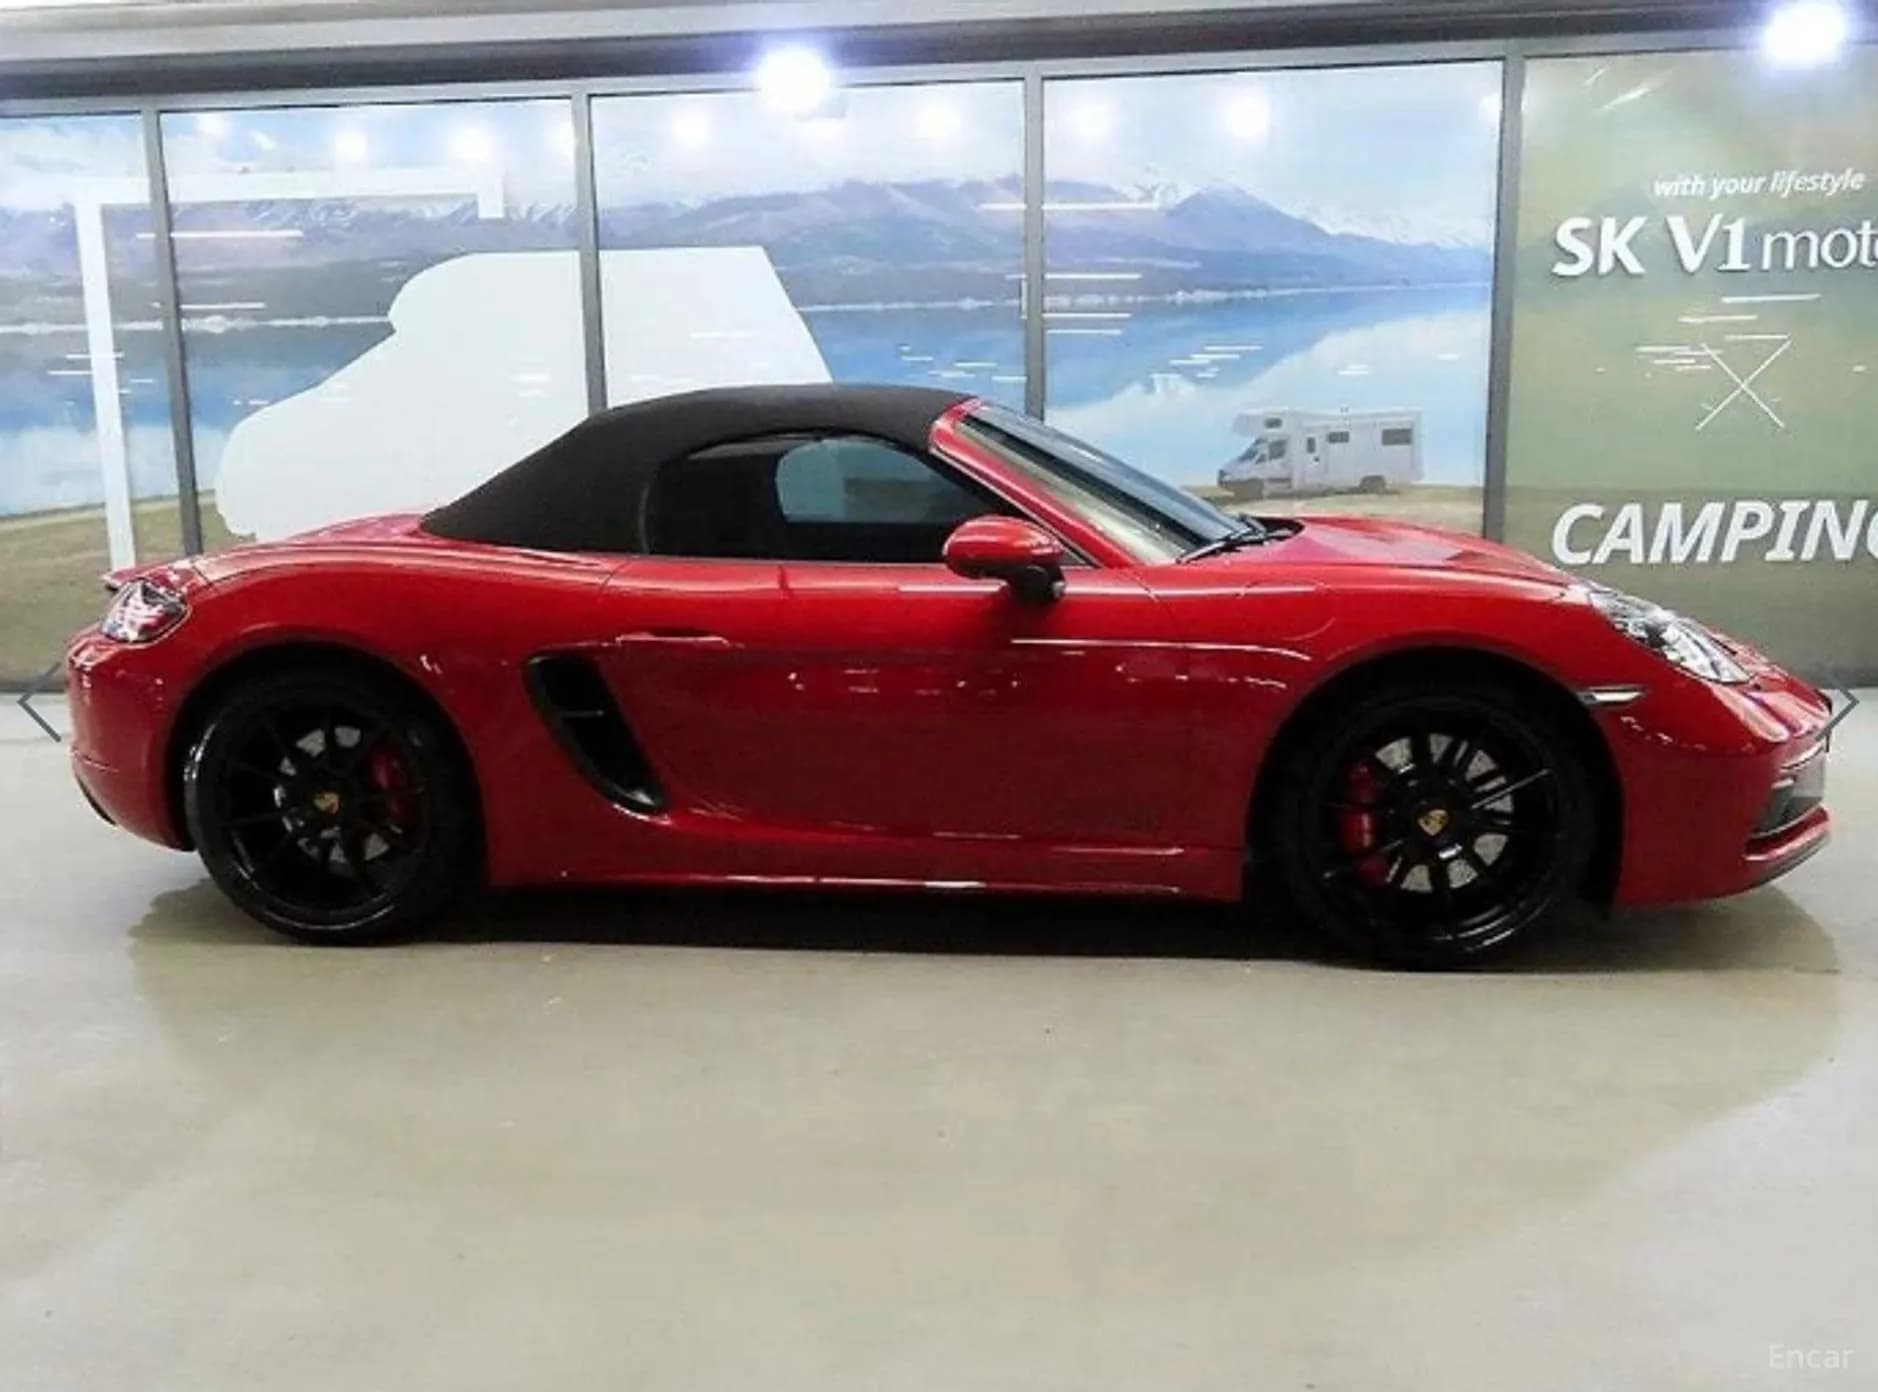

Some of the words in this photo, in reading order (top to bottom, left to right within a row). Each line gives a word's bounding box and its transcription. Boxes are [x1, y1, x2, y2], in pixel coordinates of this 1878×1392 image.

[1653, 174, 1707, 197] with
[1710, 174, 1766, 200] your
[1769, 168, 1866, 198] lifestyle
[1551, 216, 1648, 277] SK
[1761, 220, 1878, 270] mot
[1551, 500, 1878, 565] CAMPIN
